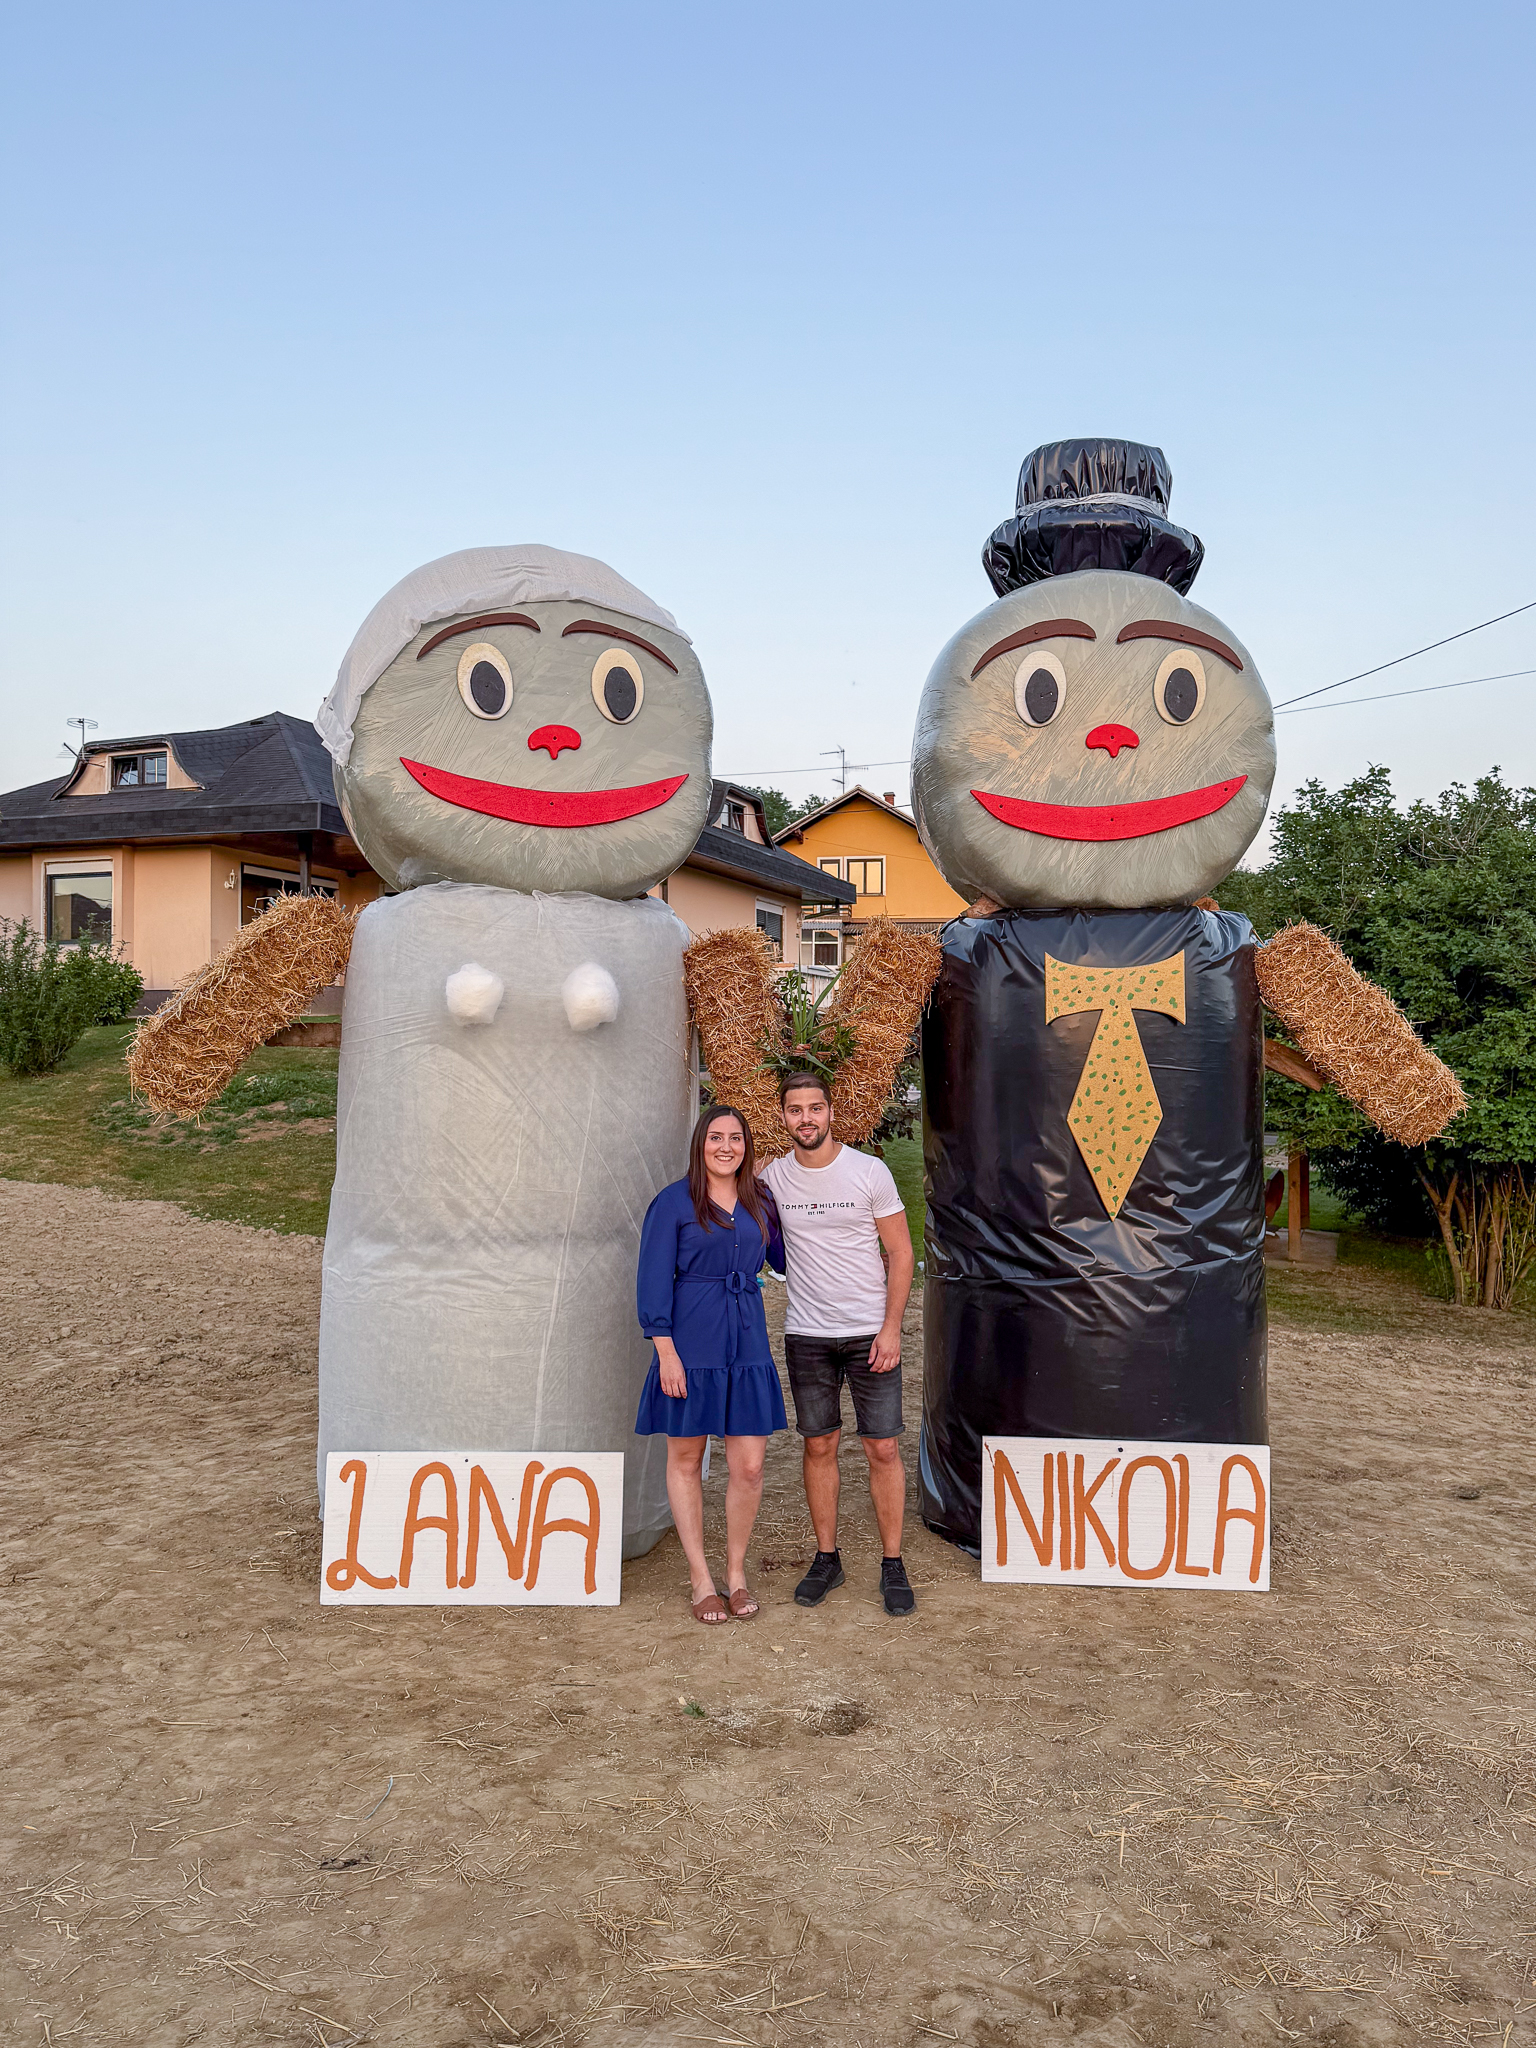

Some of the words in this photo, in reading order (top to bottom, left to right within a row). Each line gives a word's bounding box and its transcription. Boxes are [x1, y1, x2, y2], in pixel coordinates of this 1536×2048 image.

[819, 1201, 856, 1209] HILFIGER
[326, 1459, 600, 1595] LANA
[994, 1450, 1266, 1583] NIKOLA
